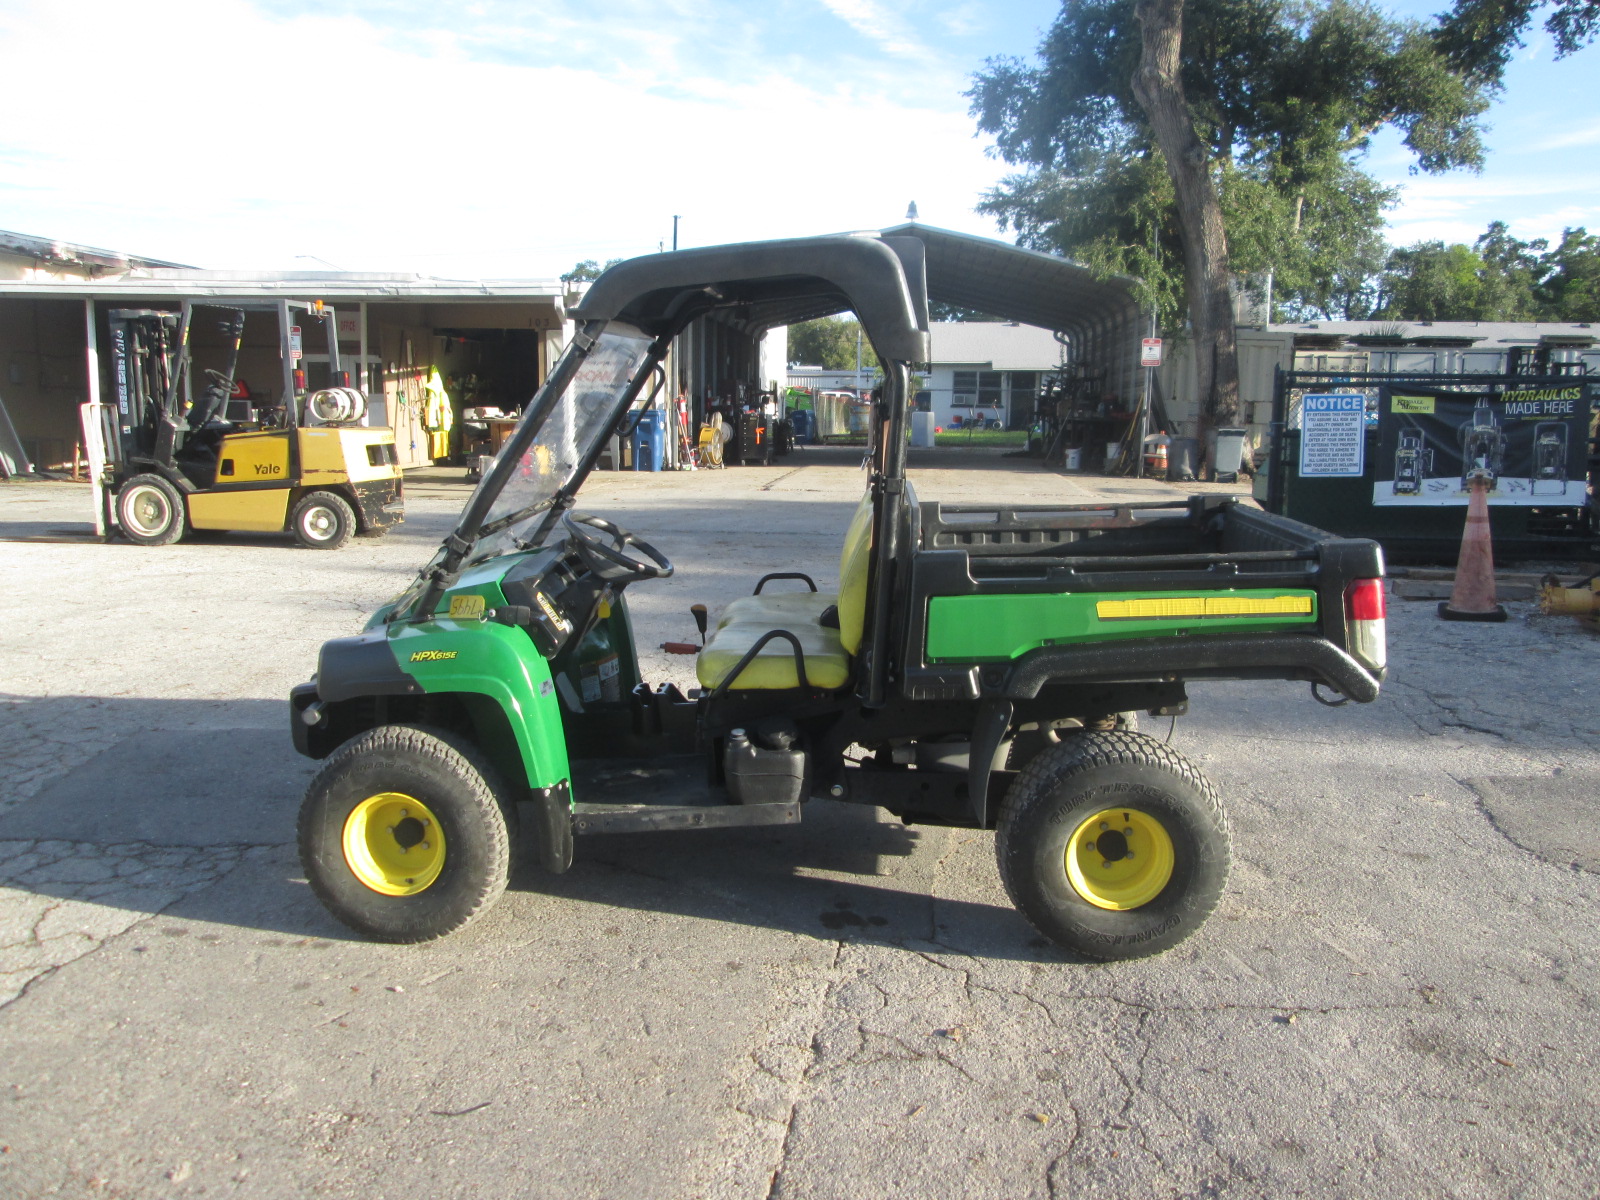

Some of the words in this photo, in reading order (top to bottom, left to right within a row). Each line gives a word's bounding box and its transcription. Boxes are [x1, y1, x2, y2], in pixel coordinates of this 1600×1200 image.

[340, 320, 356, 331] OFFICE
[115, 330, 125, 358] Yale
[1500, 387, 1581, 402] HYDRAULICS
[1306, 398, 1361, 410] NOTICE
[1505, 402, 1540, 414] MADE
[1544, 401, 1574, 413] HERE
[254, 463, 281, 475] Yale
[410, 650, 458, 663] HPX615E
[1049, 784, 1098, 825] TURF
[1099, 781, 1161, 797] TRAC
[1073, 912, 1183, 946] CARLISLE
